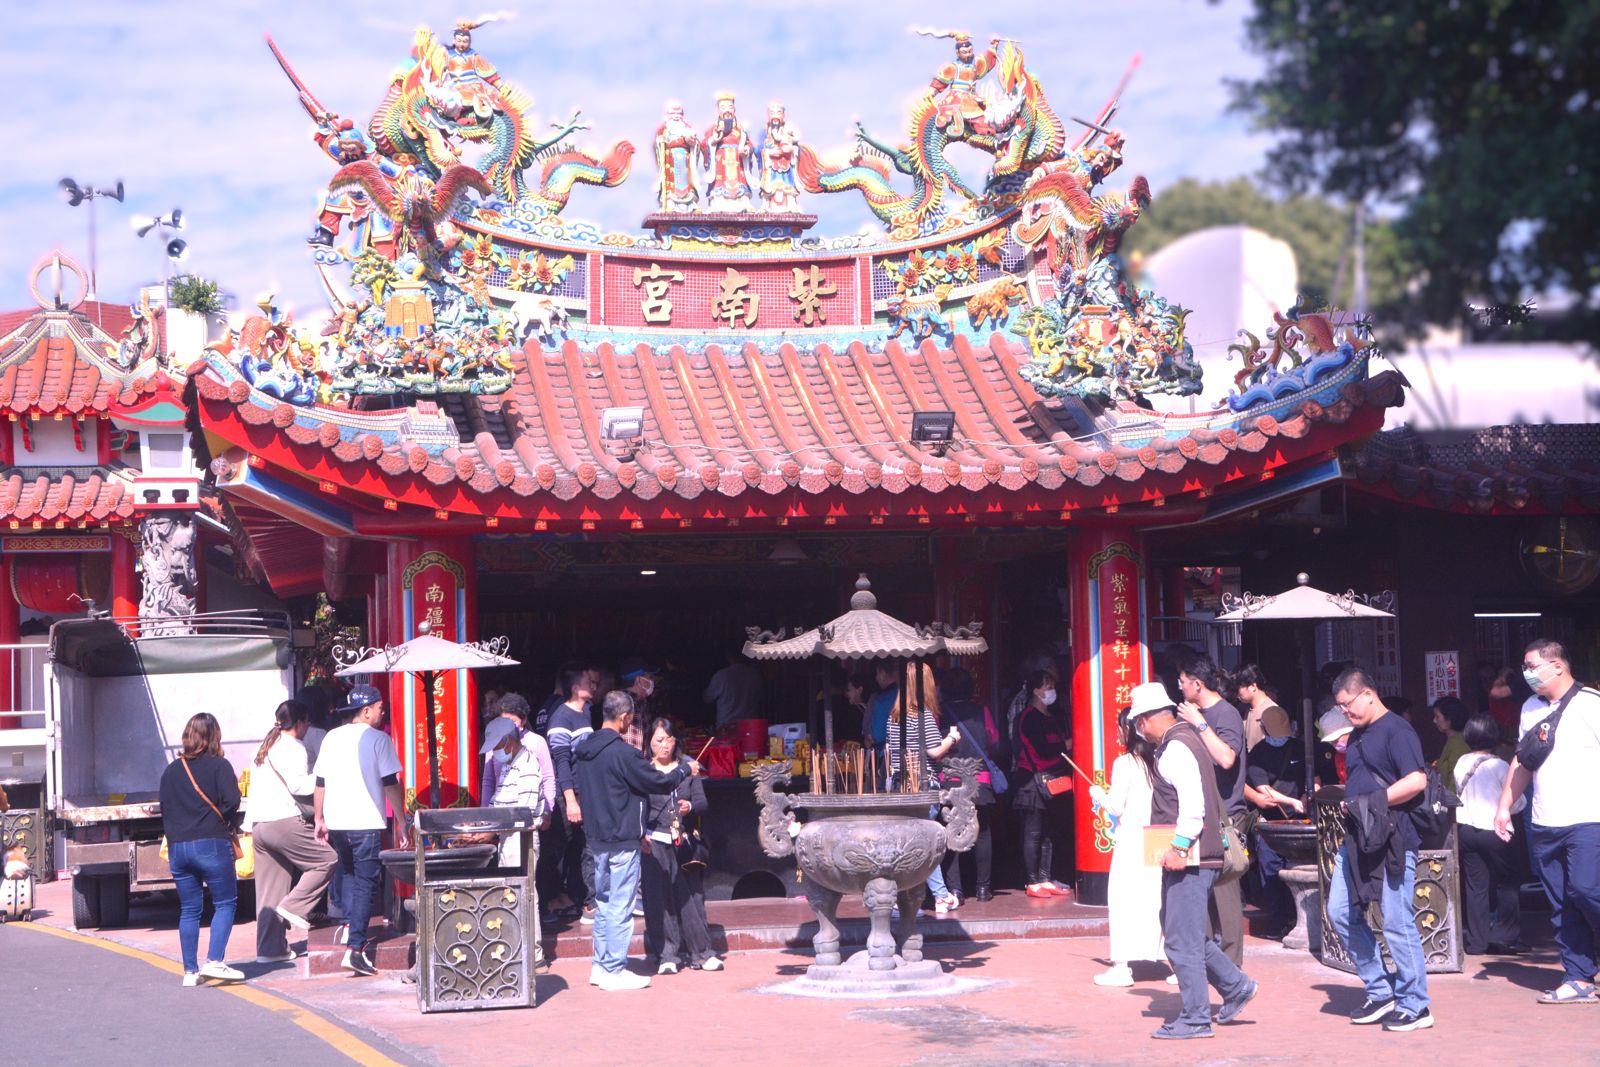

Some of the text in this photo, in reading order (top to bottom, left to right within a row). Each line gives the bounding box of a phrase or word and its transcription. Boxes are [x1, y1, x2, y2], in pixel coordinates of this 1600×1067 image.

[1110, 572, 1131, 757] 紫氣呈祥十莊
